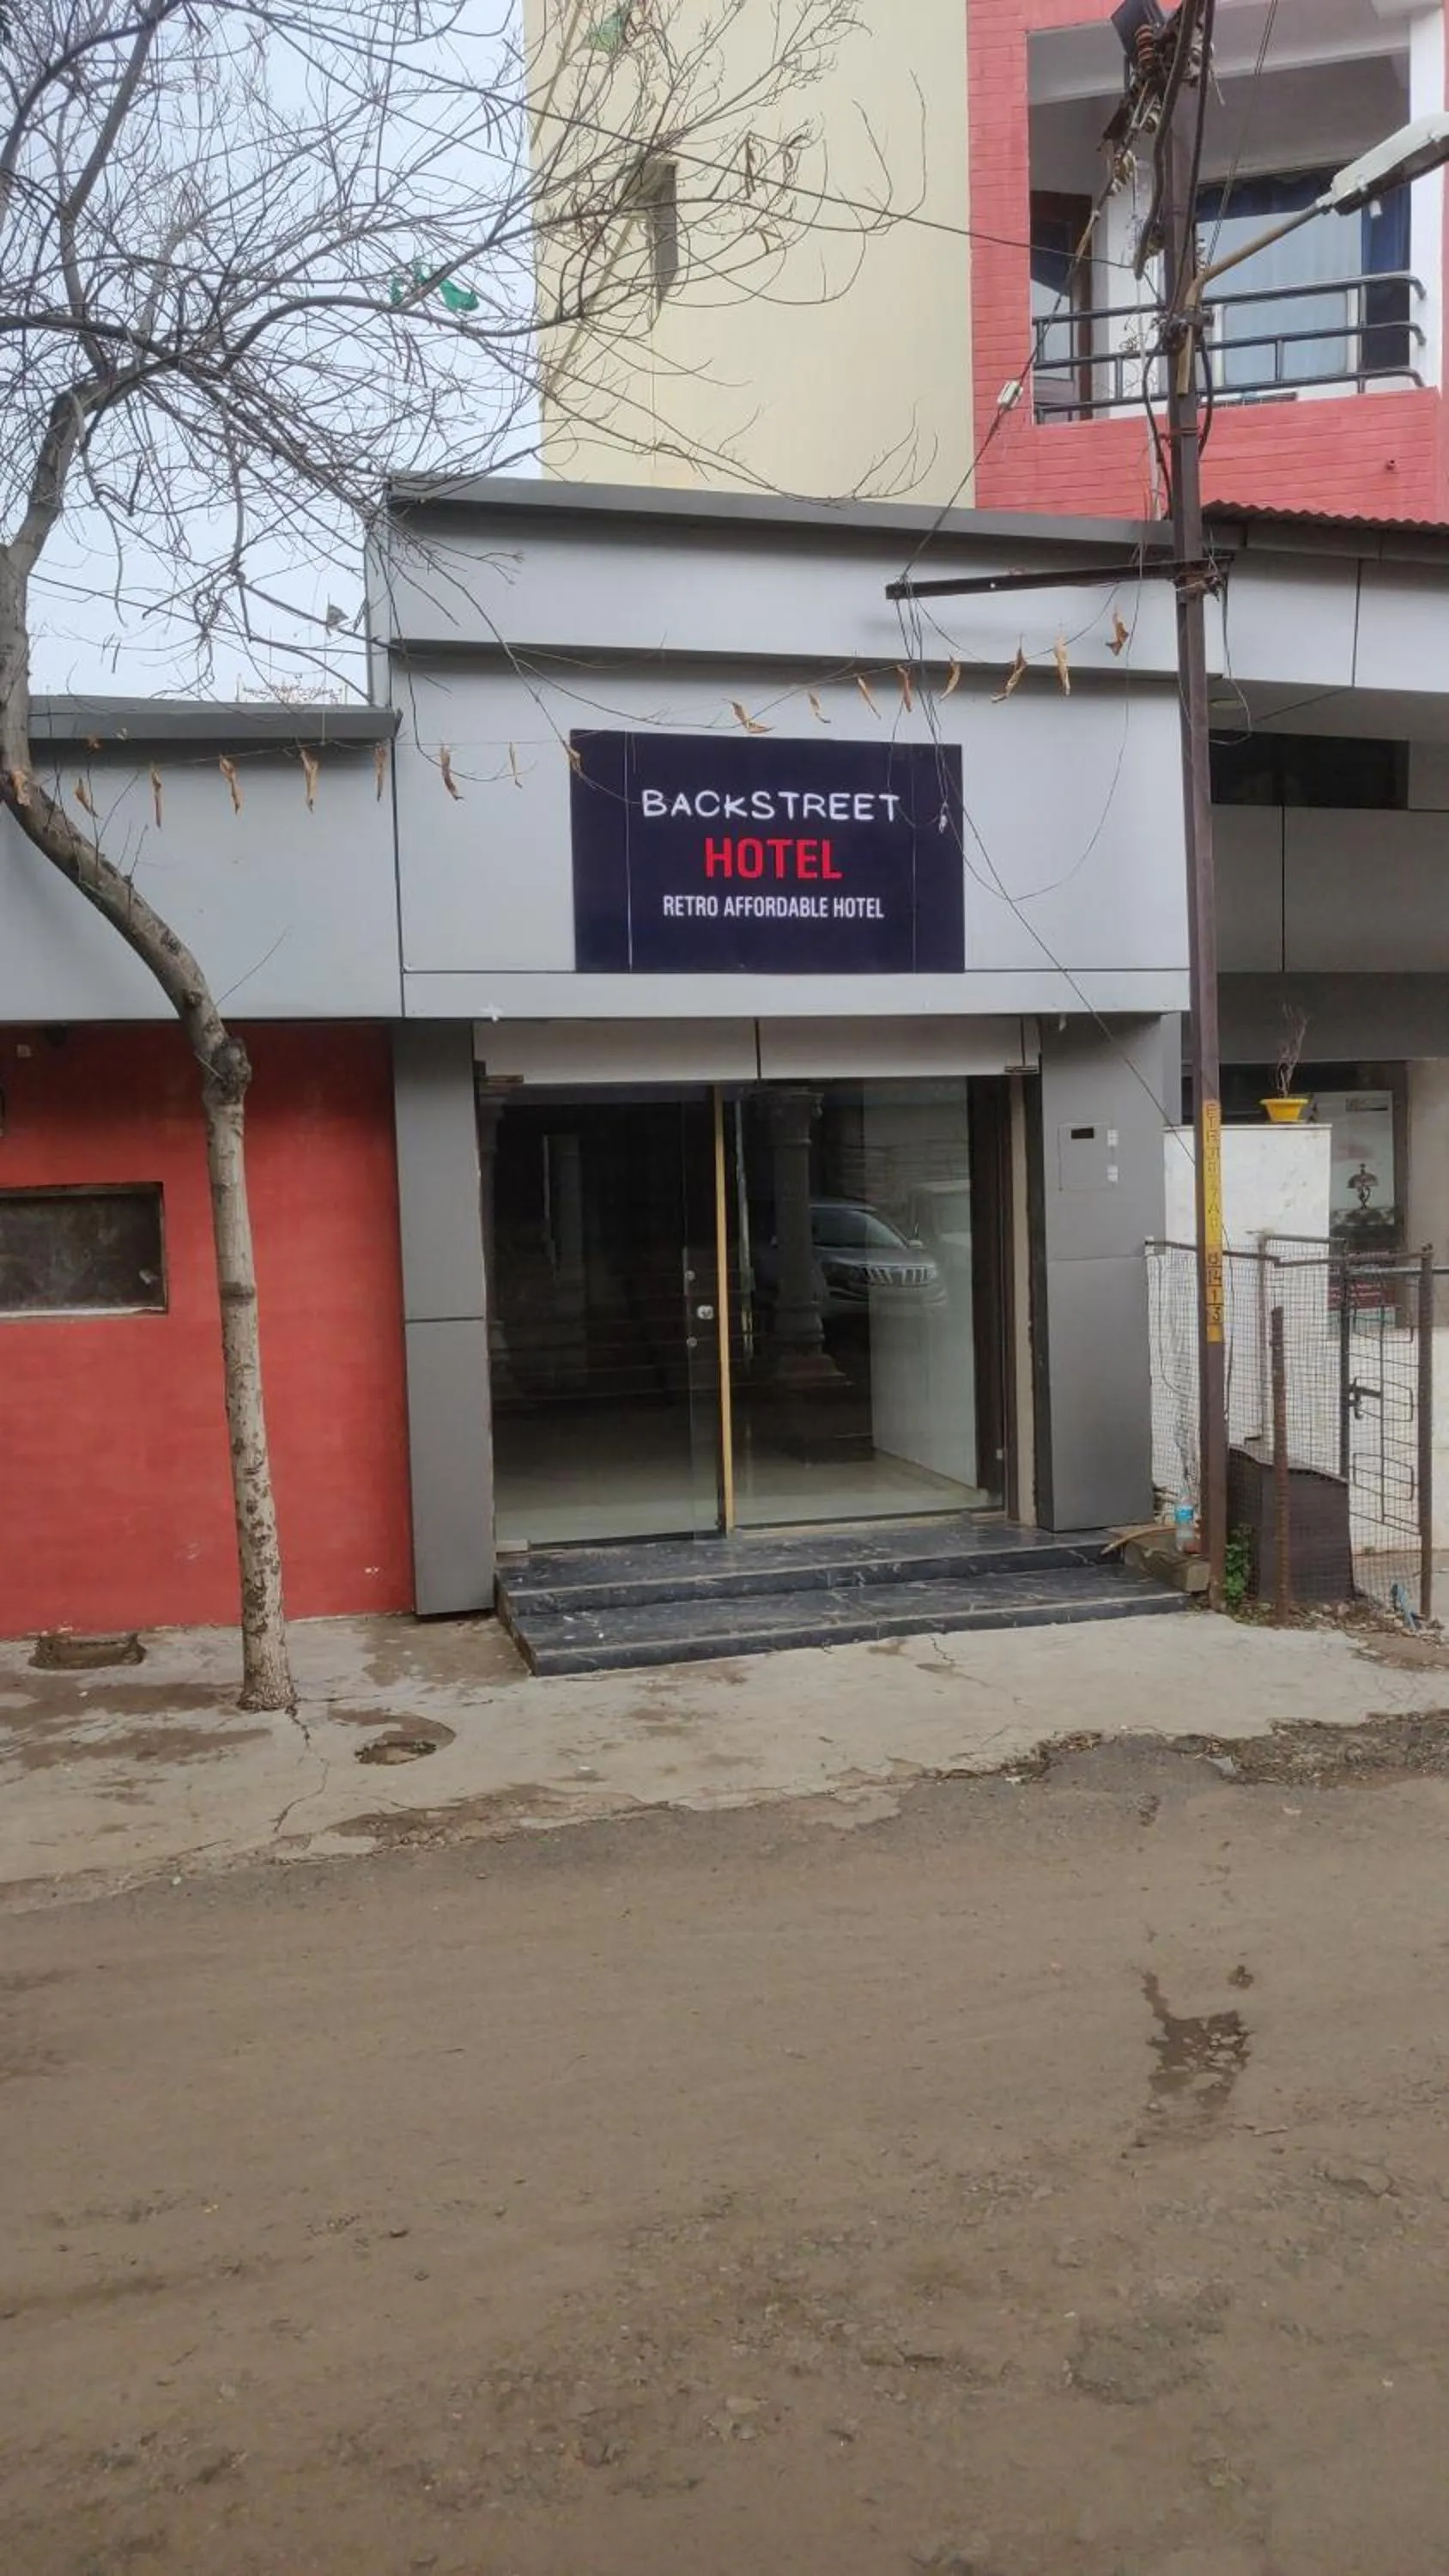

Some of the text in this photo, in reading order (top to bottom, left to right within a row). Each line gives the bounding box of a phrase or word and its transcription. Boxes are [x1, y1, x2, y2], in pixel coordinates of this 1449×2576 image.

[642, 789, 900, 822] BACKSTREET
[705, 837, 843, 879] HOTEL
[663, 895, 885, 919] RETRO AFFORDABLE HOTEL
